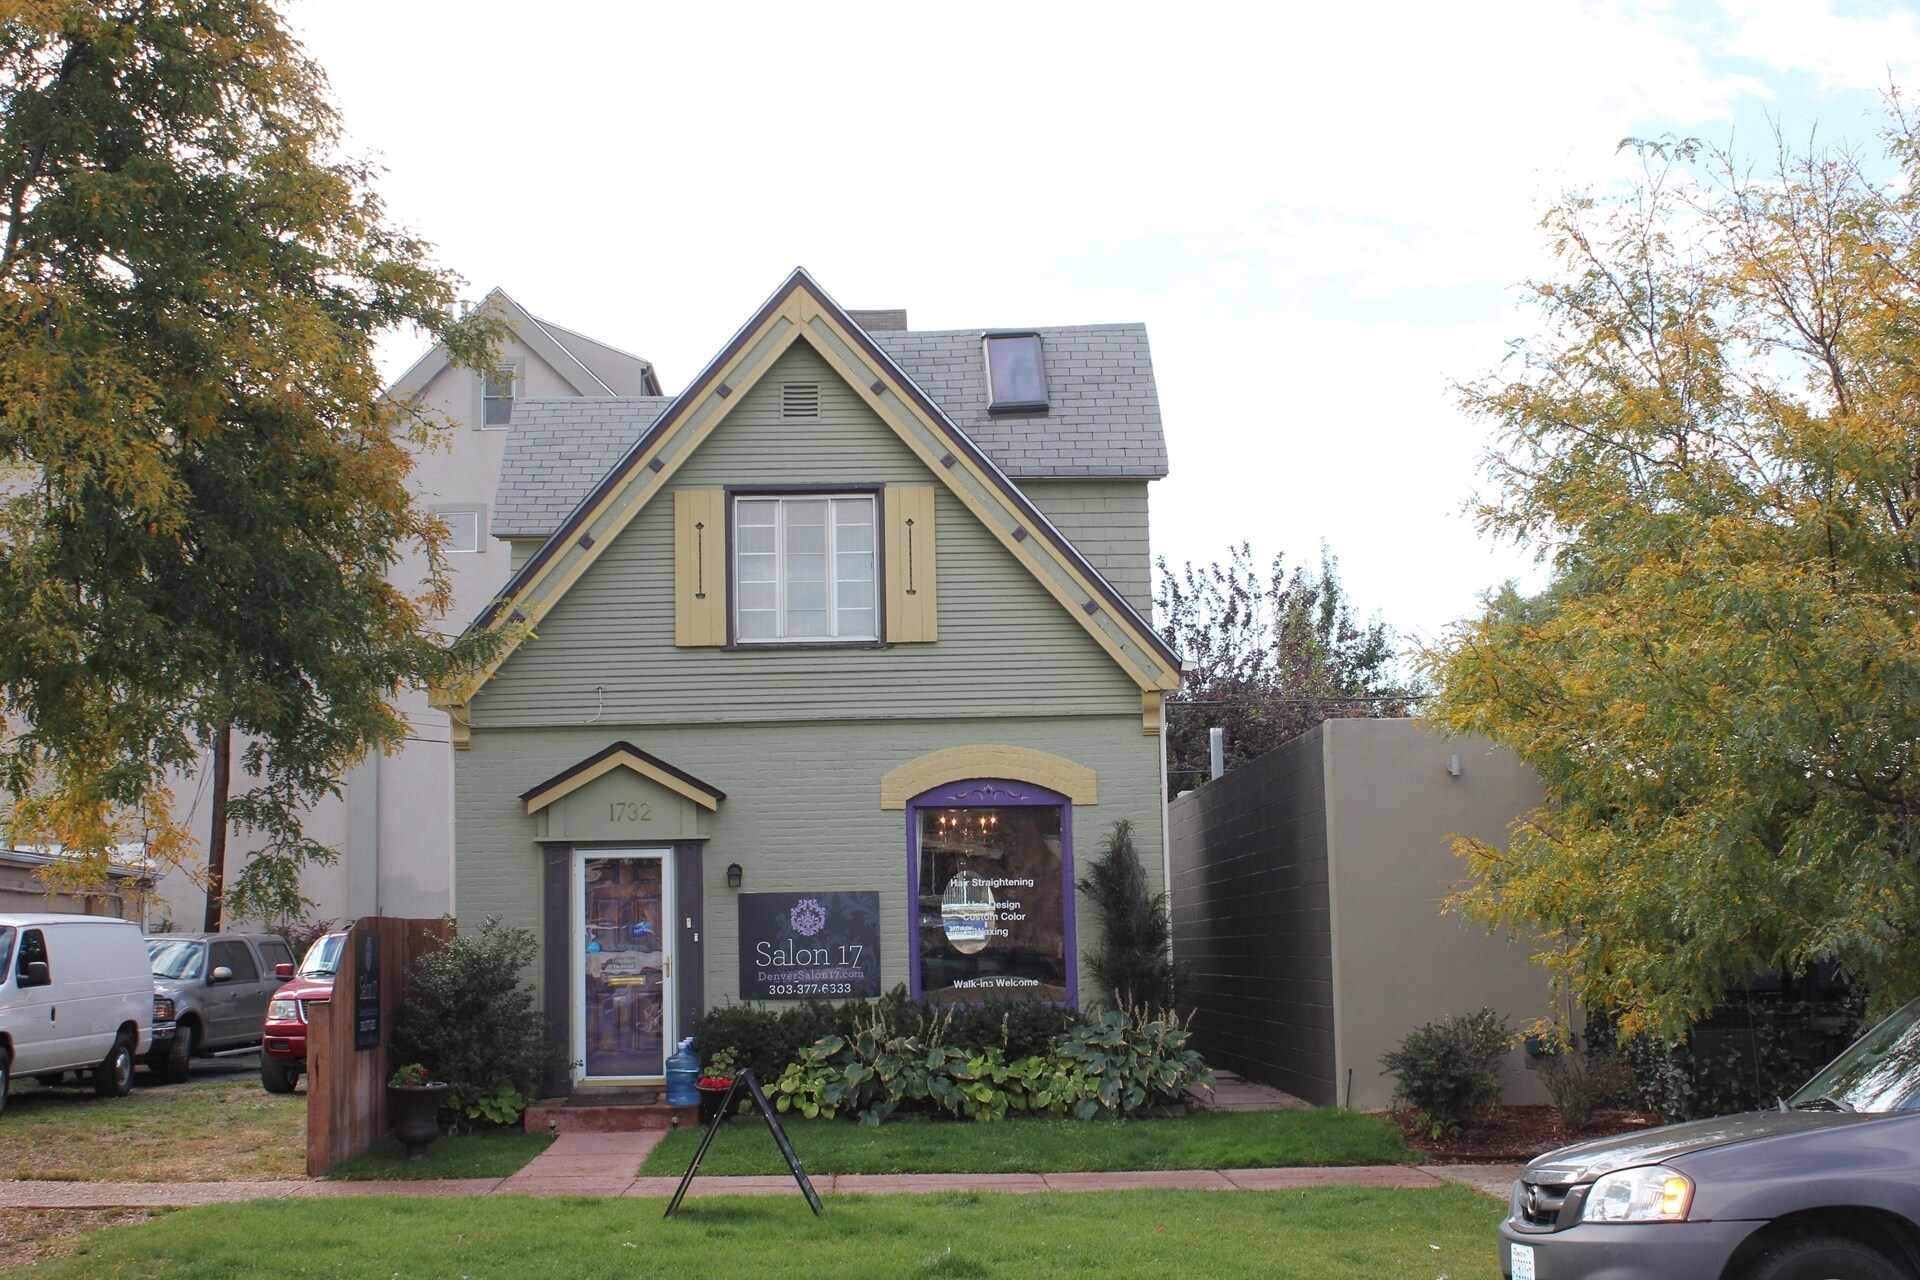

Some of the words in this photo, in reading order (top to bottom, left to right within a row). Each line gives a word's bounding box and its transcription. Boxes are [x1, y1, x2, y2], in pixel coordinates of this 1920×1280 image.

[610, 802, 652, 821] 1732
[950, 878, 969, 887] Hair
[971, 878, 1034, 888] Straightening
[1000, 912, 1026, 921] Color
[756, 939, 830, 967] Salon
[838, 945, 863, 969] 17
[758, 970, 864, 981] DenverSalon17.com
[769, 983, 851, 995] 303.377.6333
[953, 980, 994, 988] Walk-ins
[996, 979, 1039, 987] Welcome
